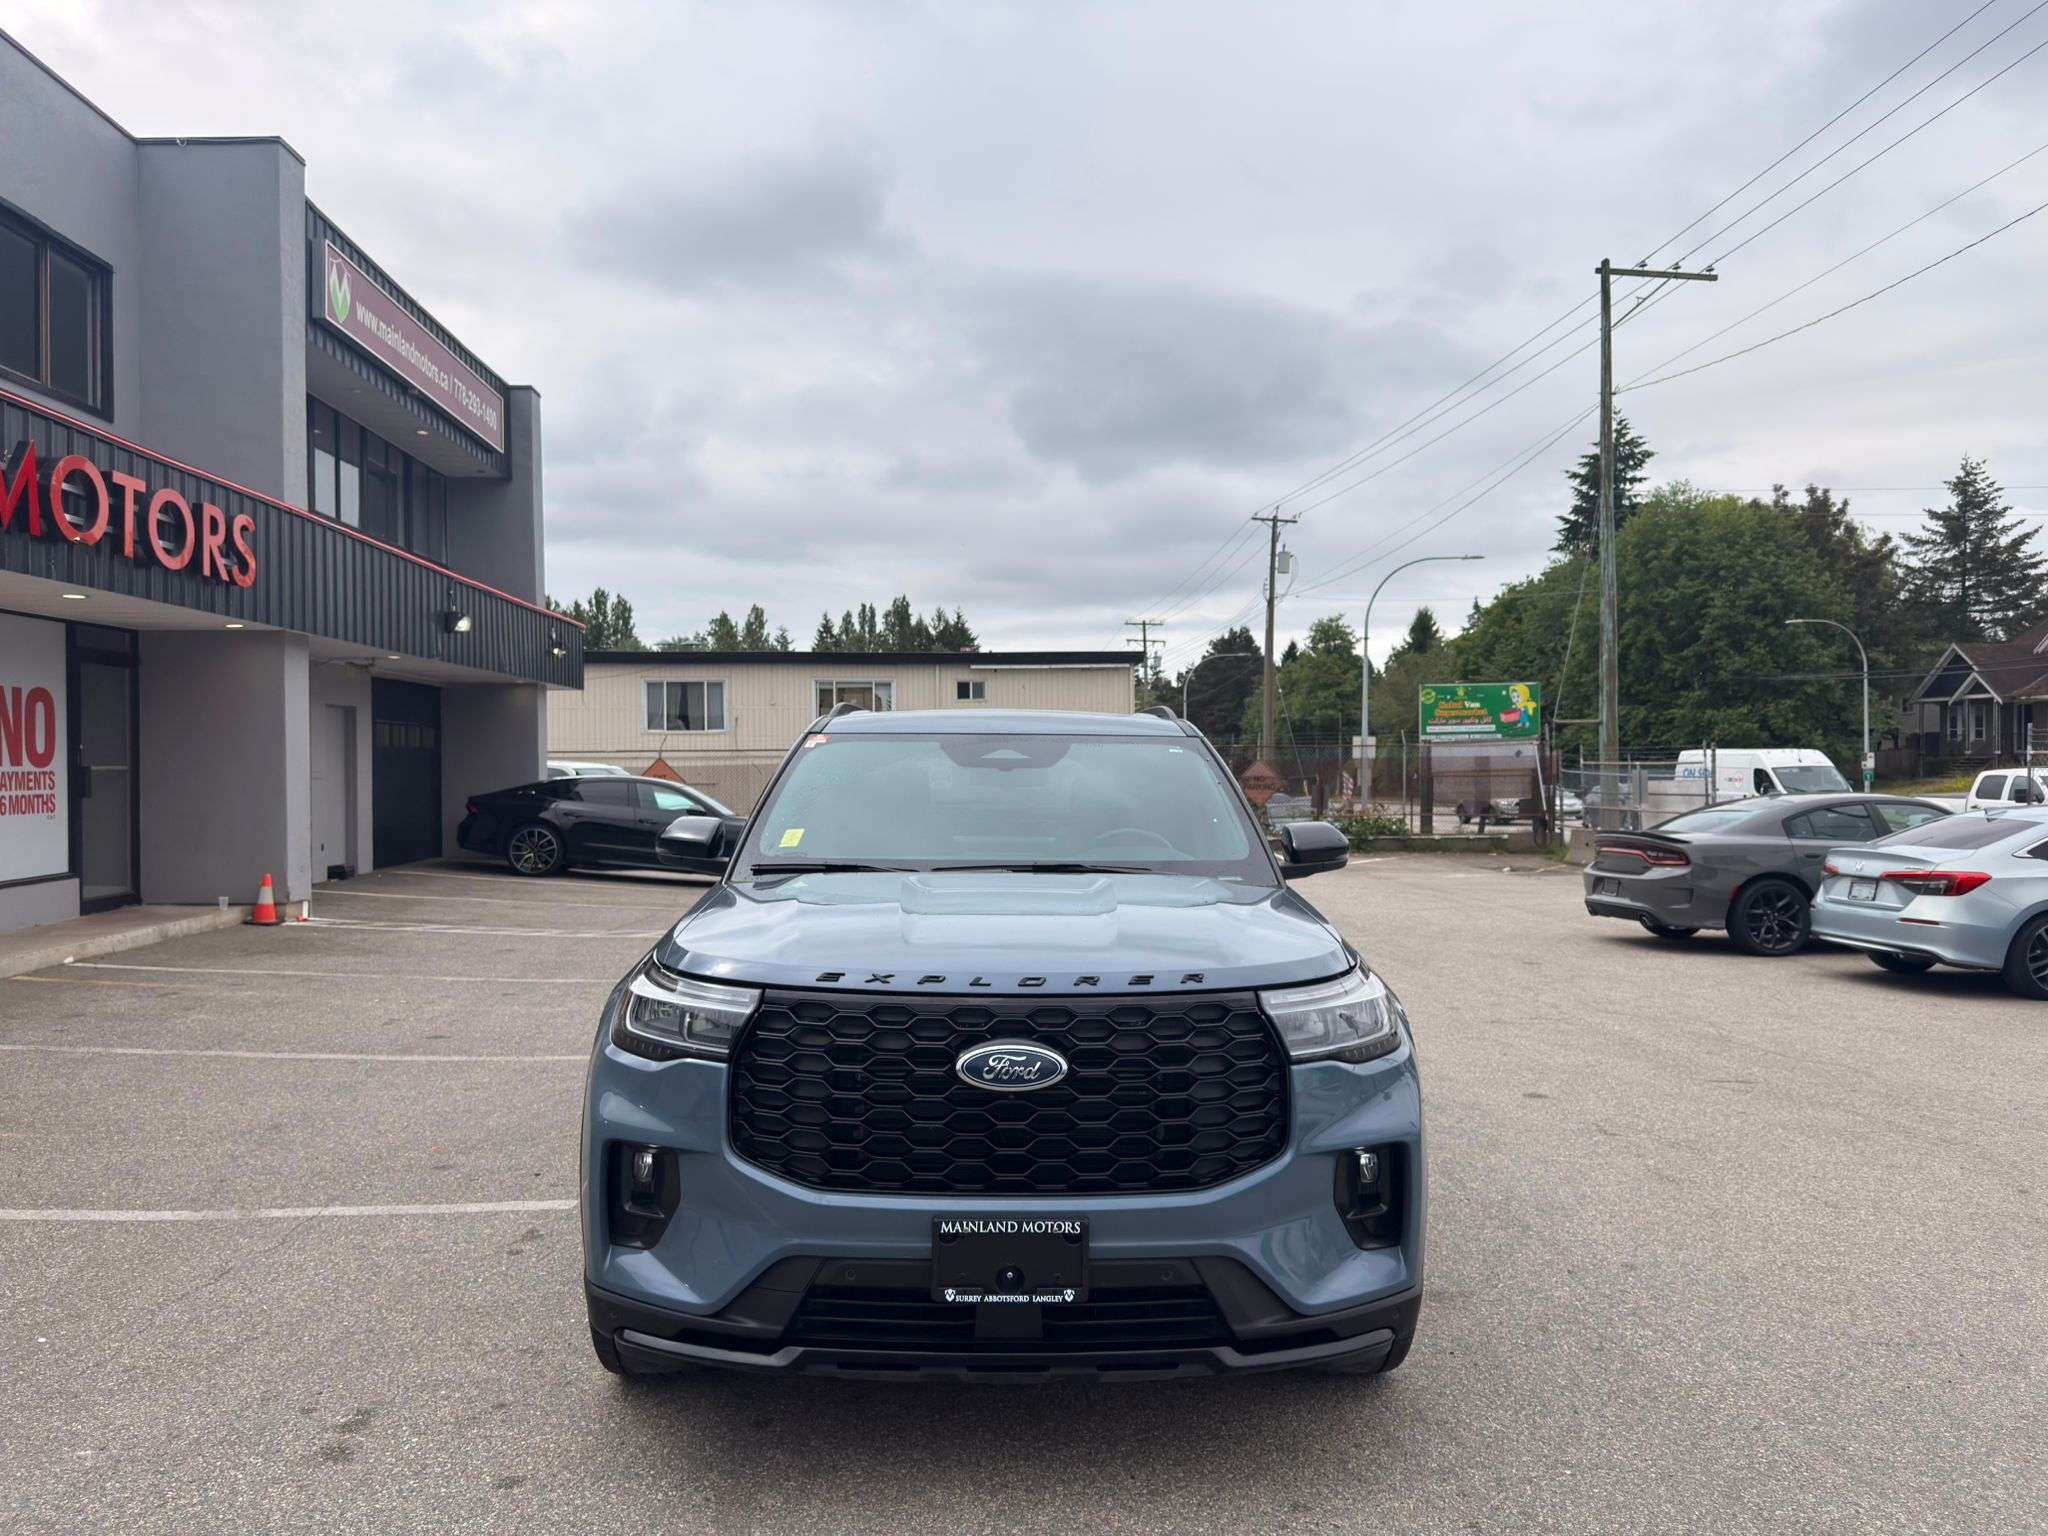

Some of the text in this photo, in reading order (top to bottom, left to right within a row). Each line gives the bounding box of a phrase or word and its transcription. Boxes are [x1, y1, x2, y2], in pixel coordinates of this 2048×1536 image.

[356, 300, 449, 391] www.mainlandmotors.ca
[453, 377, 497, 432] 778-293-1400
[0, 439, 257, 588] MOTORS
[0, 686, 56, 769] NO
[0, 794, 56, 816] 6 MONTHS
[815, 972, 1206, 987] EXPLORER
[982, 1054, 1041, 1080] Ford
[940, 1221, 1081, 1234] MAINLAND MOTORS
[955, 1295, 1063, 1303] SURREY ABBOTSFORD LANGLEY
